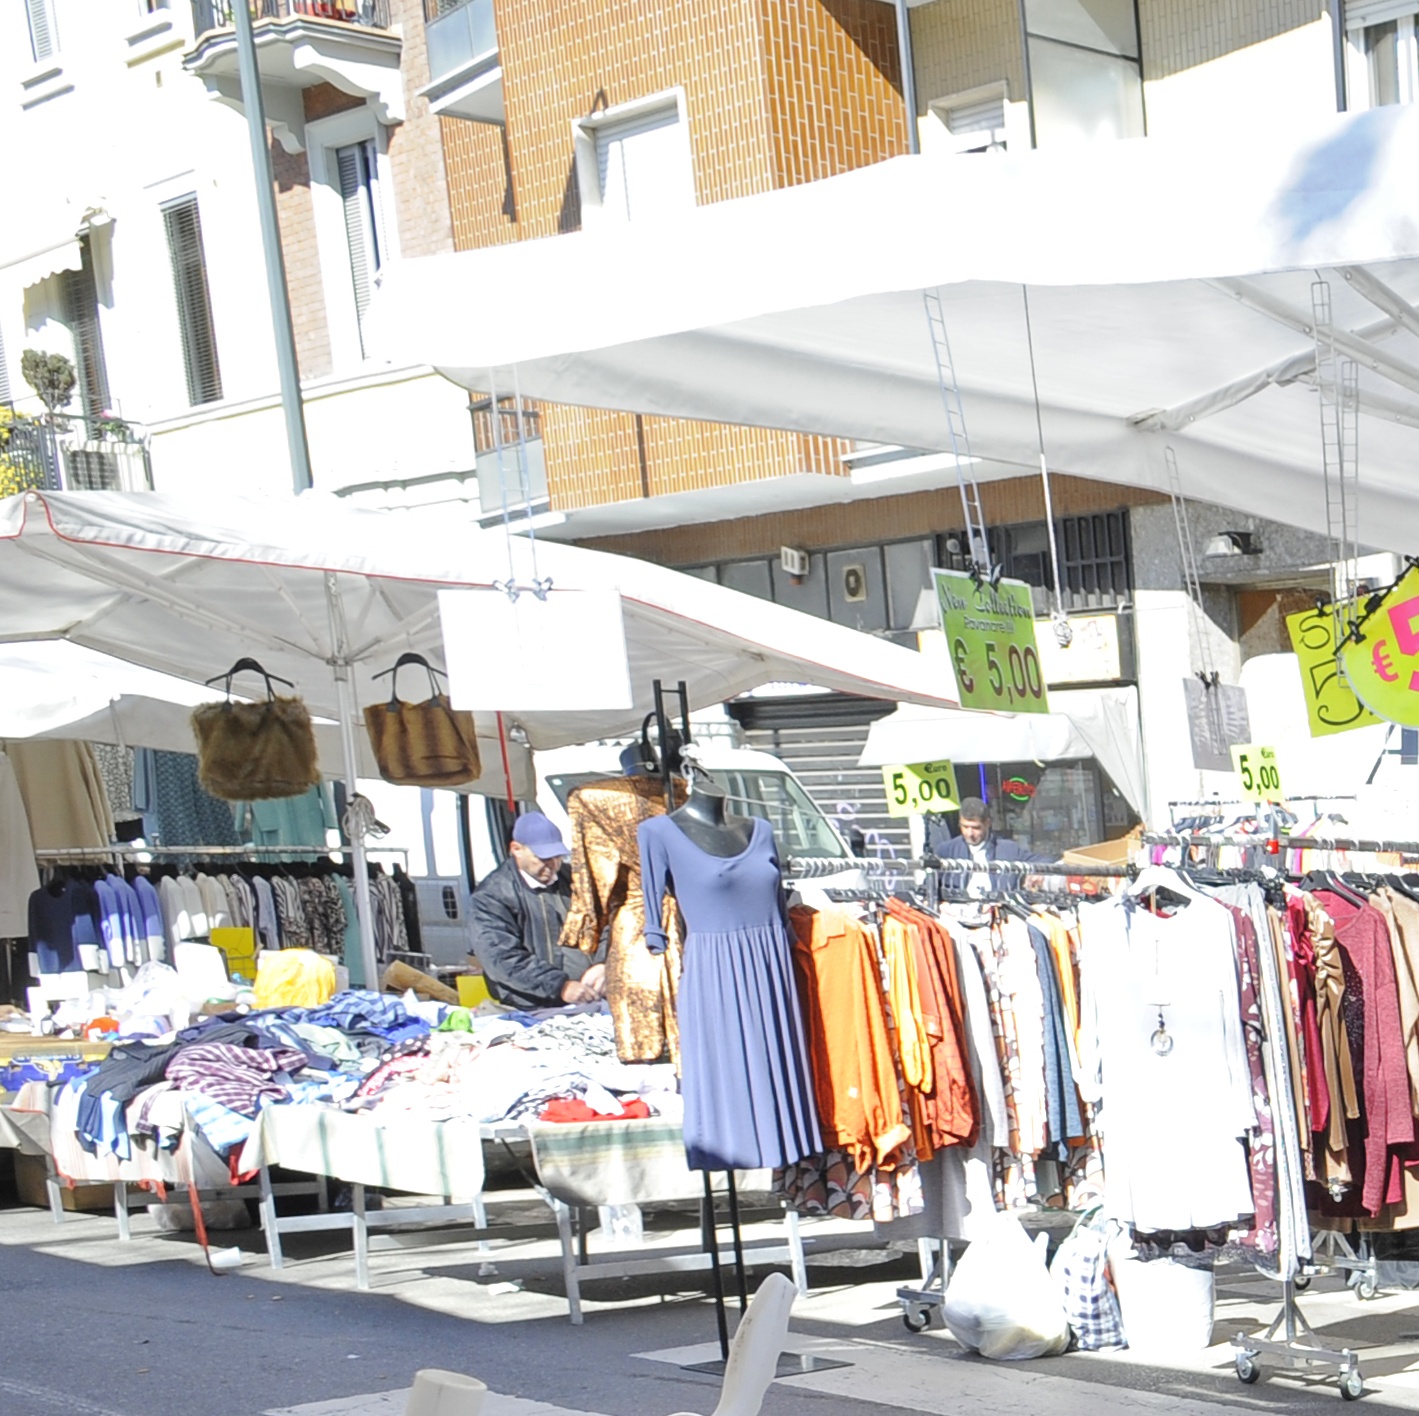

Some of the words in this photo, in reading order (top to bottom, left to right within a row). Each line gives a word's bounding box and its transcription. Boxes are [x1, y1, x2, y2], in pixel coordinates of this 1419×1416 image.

[940, 582, 967, 614] New
[974, 589, 1032, 619] Collection
[985, 641, 1042, 705] 5,00
[892, 772, 951, 808] 5,00
[1240, 754, 1280, 796] 5,00
